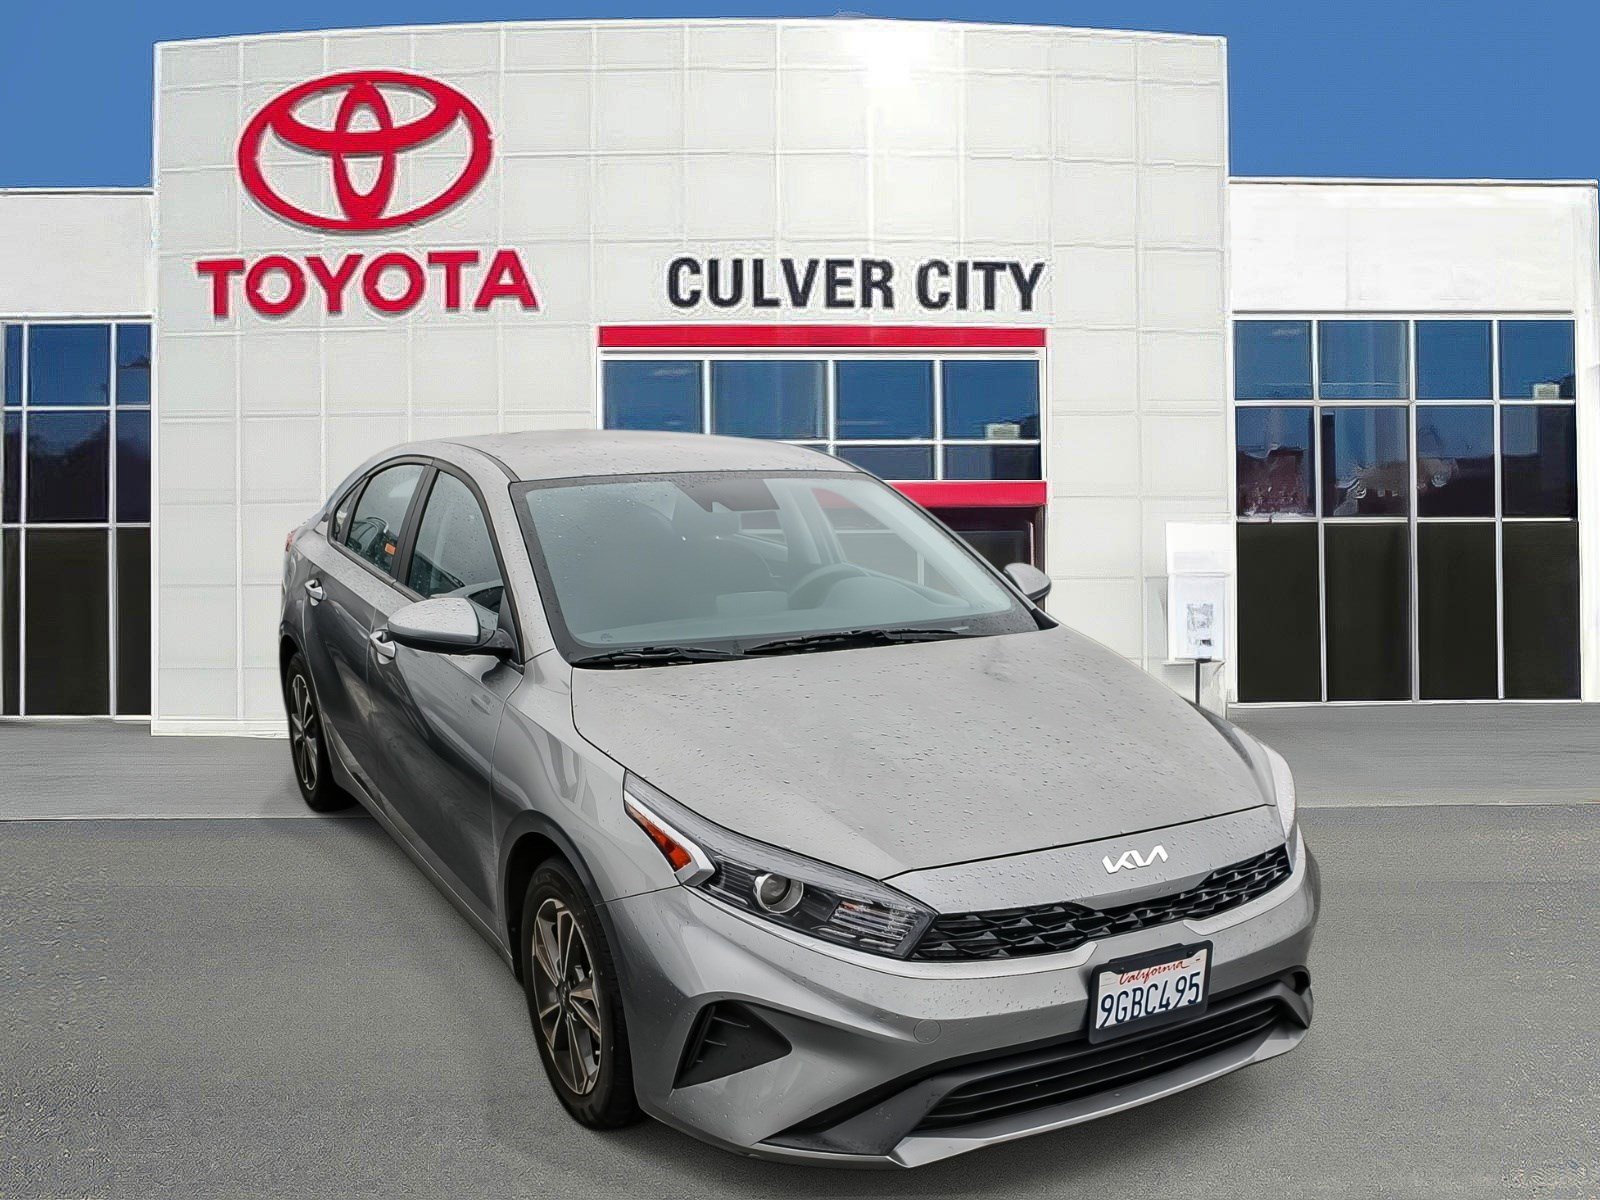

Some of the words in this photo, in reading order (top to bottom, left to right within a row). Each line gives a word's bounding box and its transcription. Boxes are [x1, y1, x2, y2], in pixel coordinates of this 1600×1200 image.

[197, 250, 538, 317] TOYOTA
[667, 257, 895, 309] CULVER
[917, 260, 1046, 311] CITY
[1099, 972, 1201, 1029] 9GBC495
[1119, 960, 1190, 986] California
